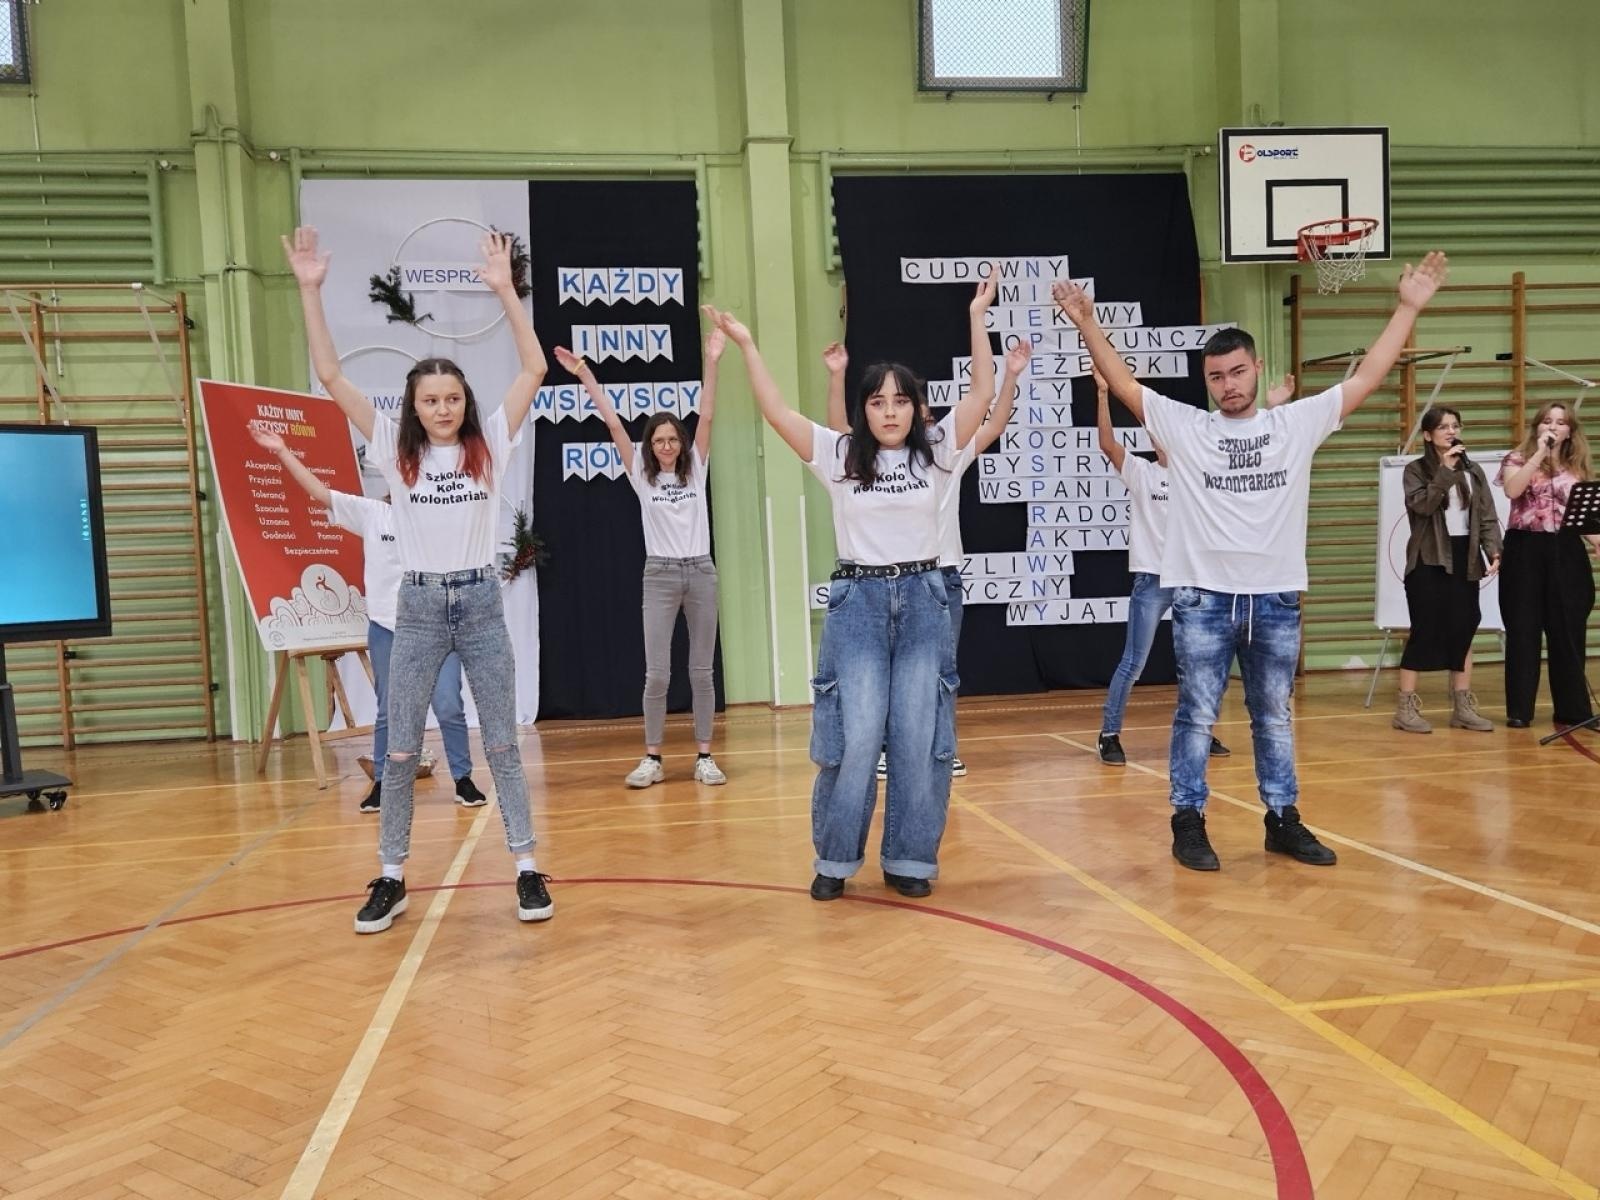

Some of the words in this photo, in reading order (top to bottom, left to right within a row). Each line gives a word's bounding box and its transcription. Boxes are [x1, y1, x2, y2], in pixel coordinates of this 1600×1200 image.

[406, 269, 482, 284] WESPRZ
[905, 260, 1063, 280] CUDOWNY
[562, 268, 680, 294] KAŻDY
[985, 306, 1136, 328] CIEKWY
[582, 329, 668, 351] INNY
[1005, 327, 1220, 351] OPIEKUŃCZ
[257, 404, 284, 419] KAŻDY
[1006, 430, 1137, 449] KOCHN
[983, 454, 1112, 475] BYSTRY
[961, 554, 1068, 575] ZLIWY
[1008, 601, 1118, 625] WYJĄT
